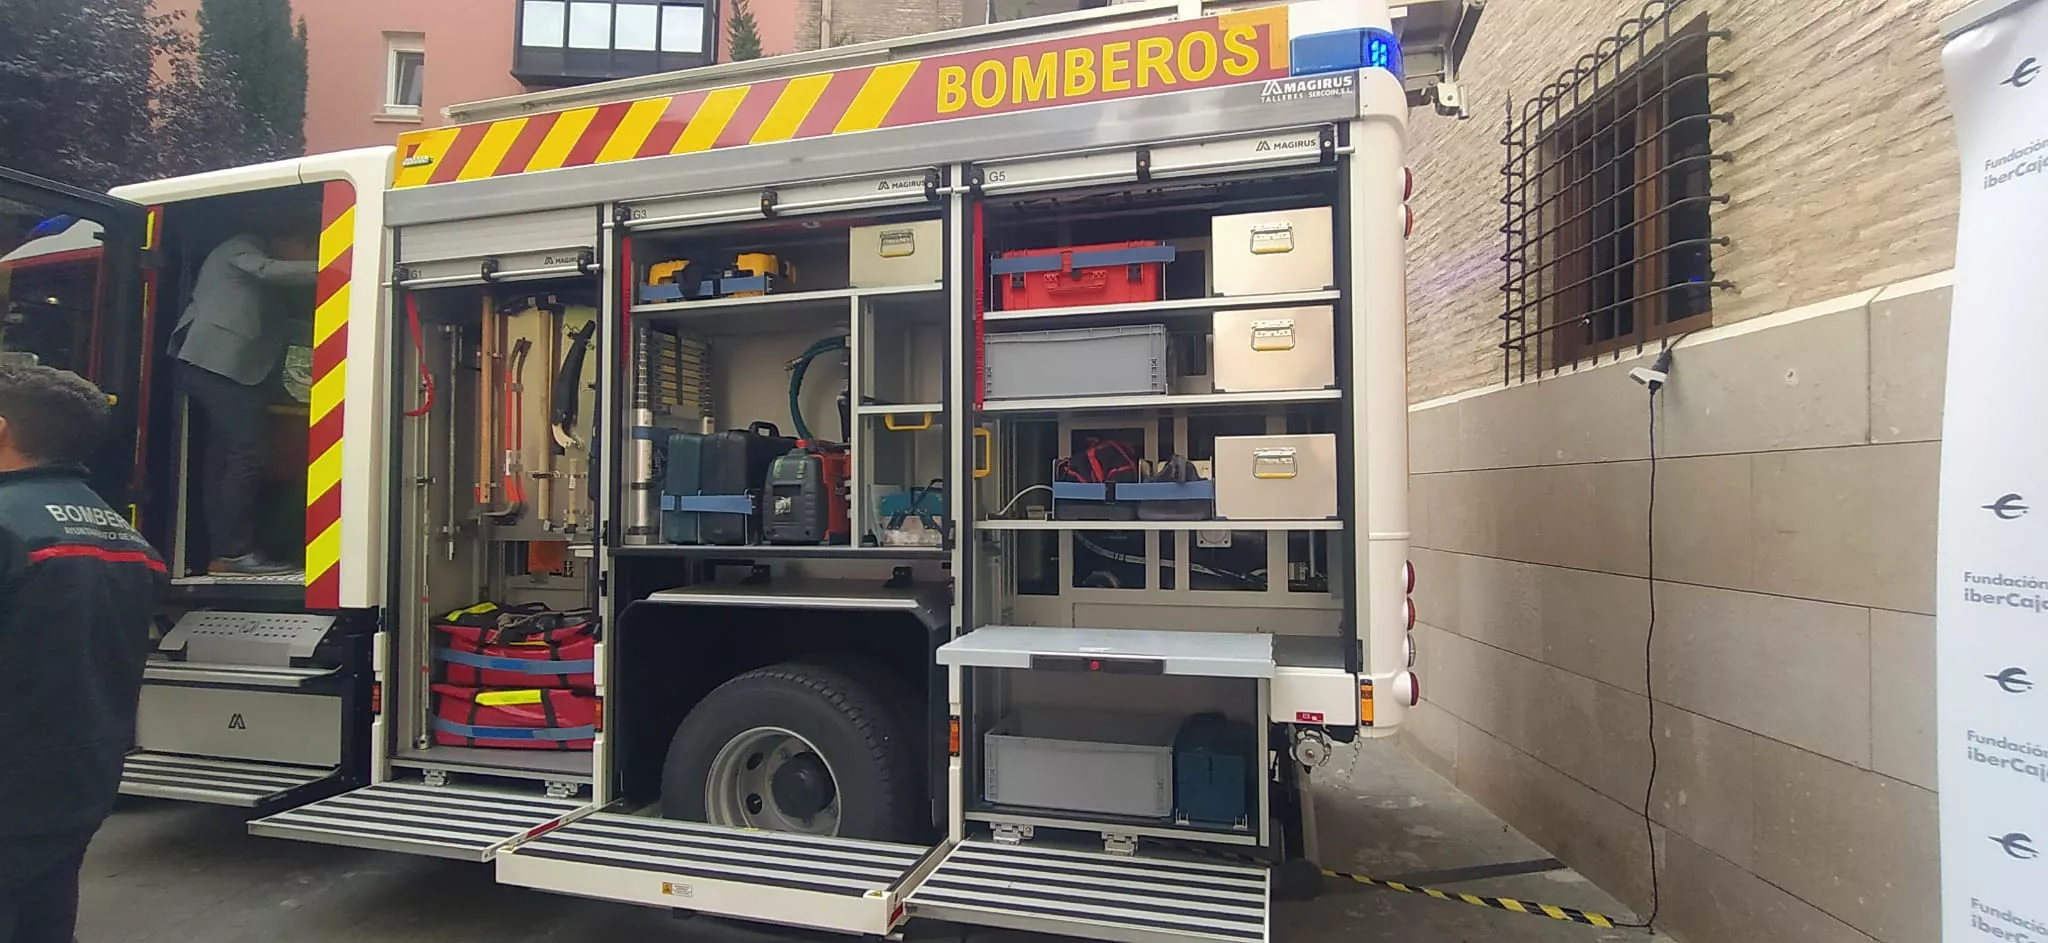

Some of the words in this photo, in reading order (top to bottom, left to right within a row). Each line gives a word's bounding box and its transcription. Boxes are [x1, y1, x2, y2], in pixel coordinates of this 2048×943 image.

[936, 24, 1260, 114] BOMBEROS
[1284, 76, 1353, 93] MAGIRUS
[1261, 93, 1304, 103] TALLERES
[1273, 139, 1317, 150] MAGIRUS
[989, 171, 1006, 182] G5
[633, 209, 647, 220] G3
[410, 270, 422, 279] G1
[1964, 571, 2048, 590] Fundación
[1968, 746, 2048, 782] iberCaj
